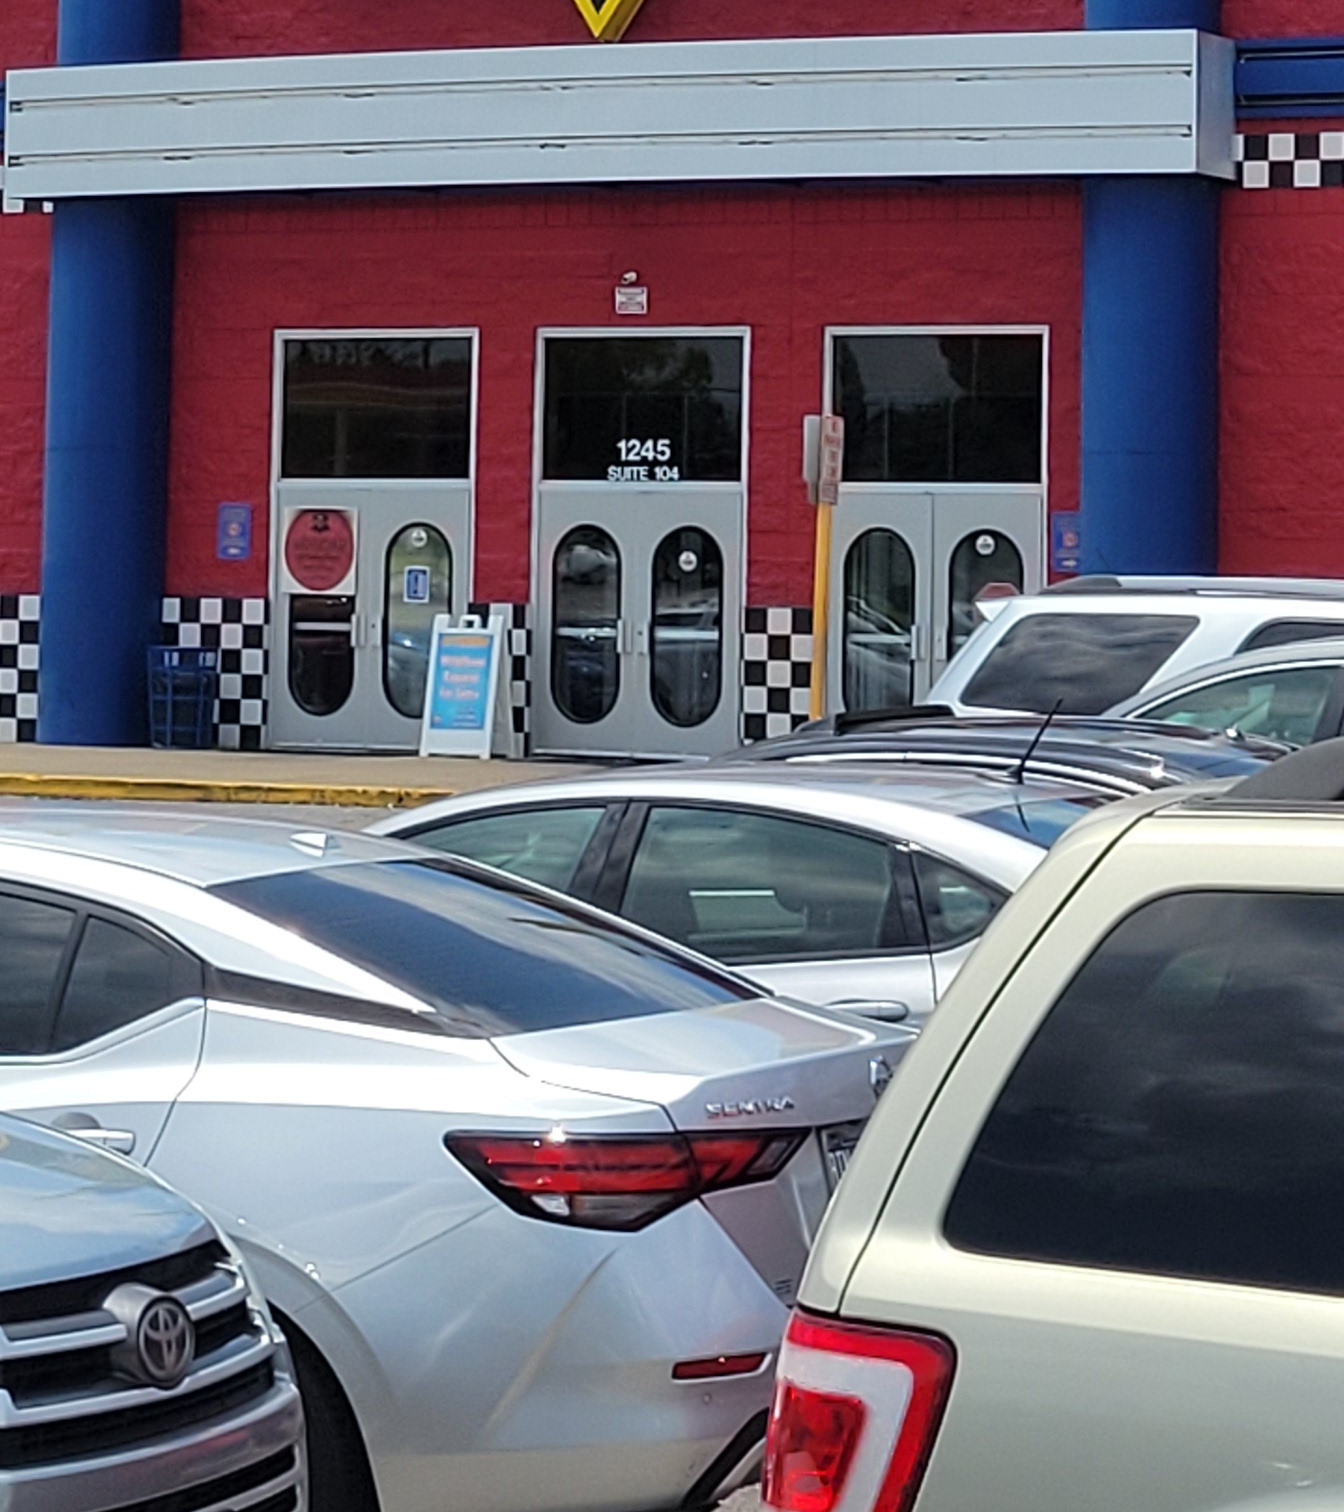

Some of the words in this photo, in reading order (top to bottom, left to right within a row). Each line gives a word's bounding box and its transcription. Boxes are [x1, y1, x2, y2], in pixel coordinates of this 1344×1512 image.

[616, 438, 671, 462] 1245
[607, 464, 650, 481] SUITE
[654, 465, 680, 481] 104
